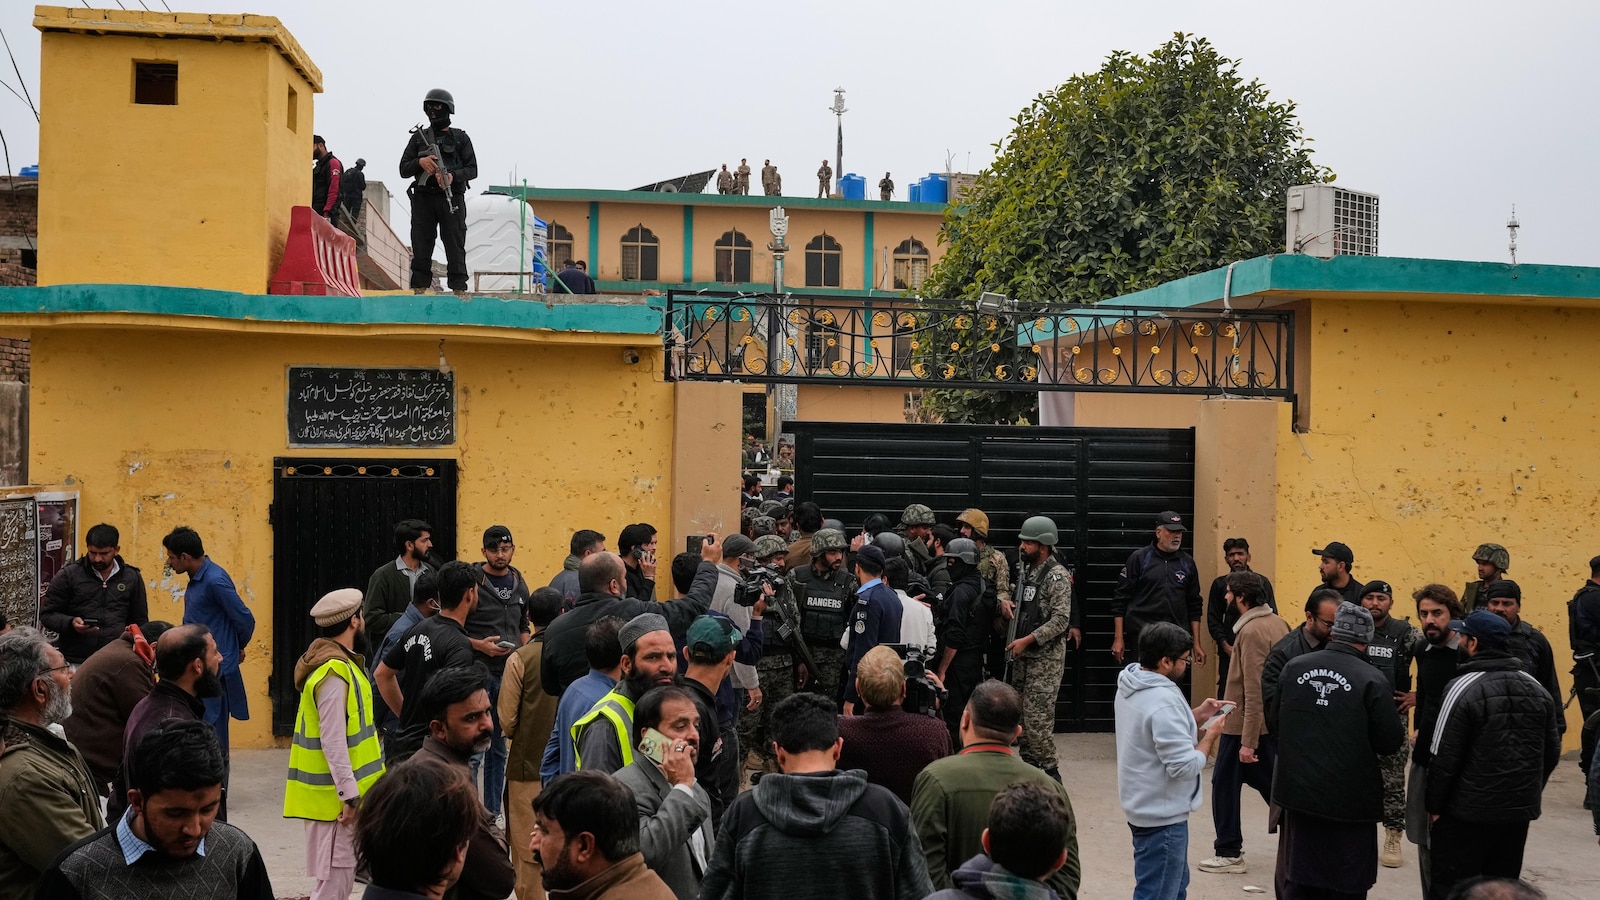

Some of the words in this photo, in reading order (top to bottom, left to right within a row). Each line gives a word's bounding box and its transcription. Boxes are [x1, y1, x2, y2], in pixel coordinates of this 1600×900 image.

[807, 597, 842, 609] RANGERS
[1368, 646, 1393, 658] GERS
[1297, 669, 1352, 692] COMMANDO
[1316, 698, 1329, 706] ATS
